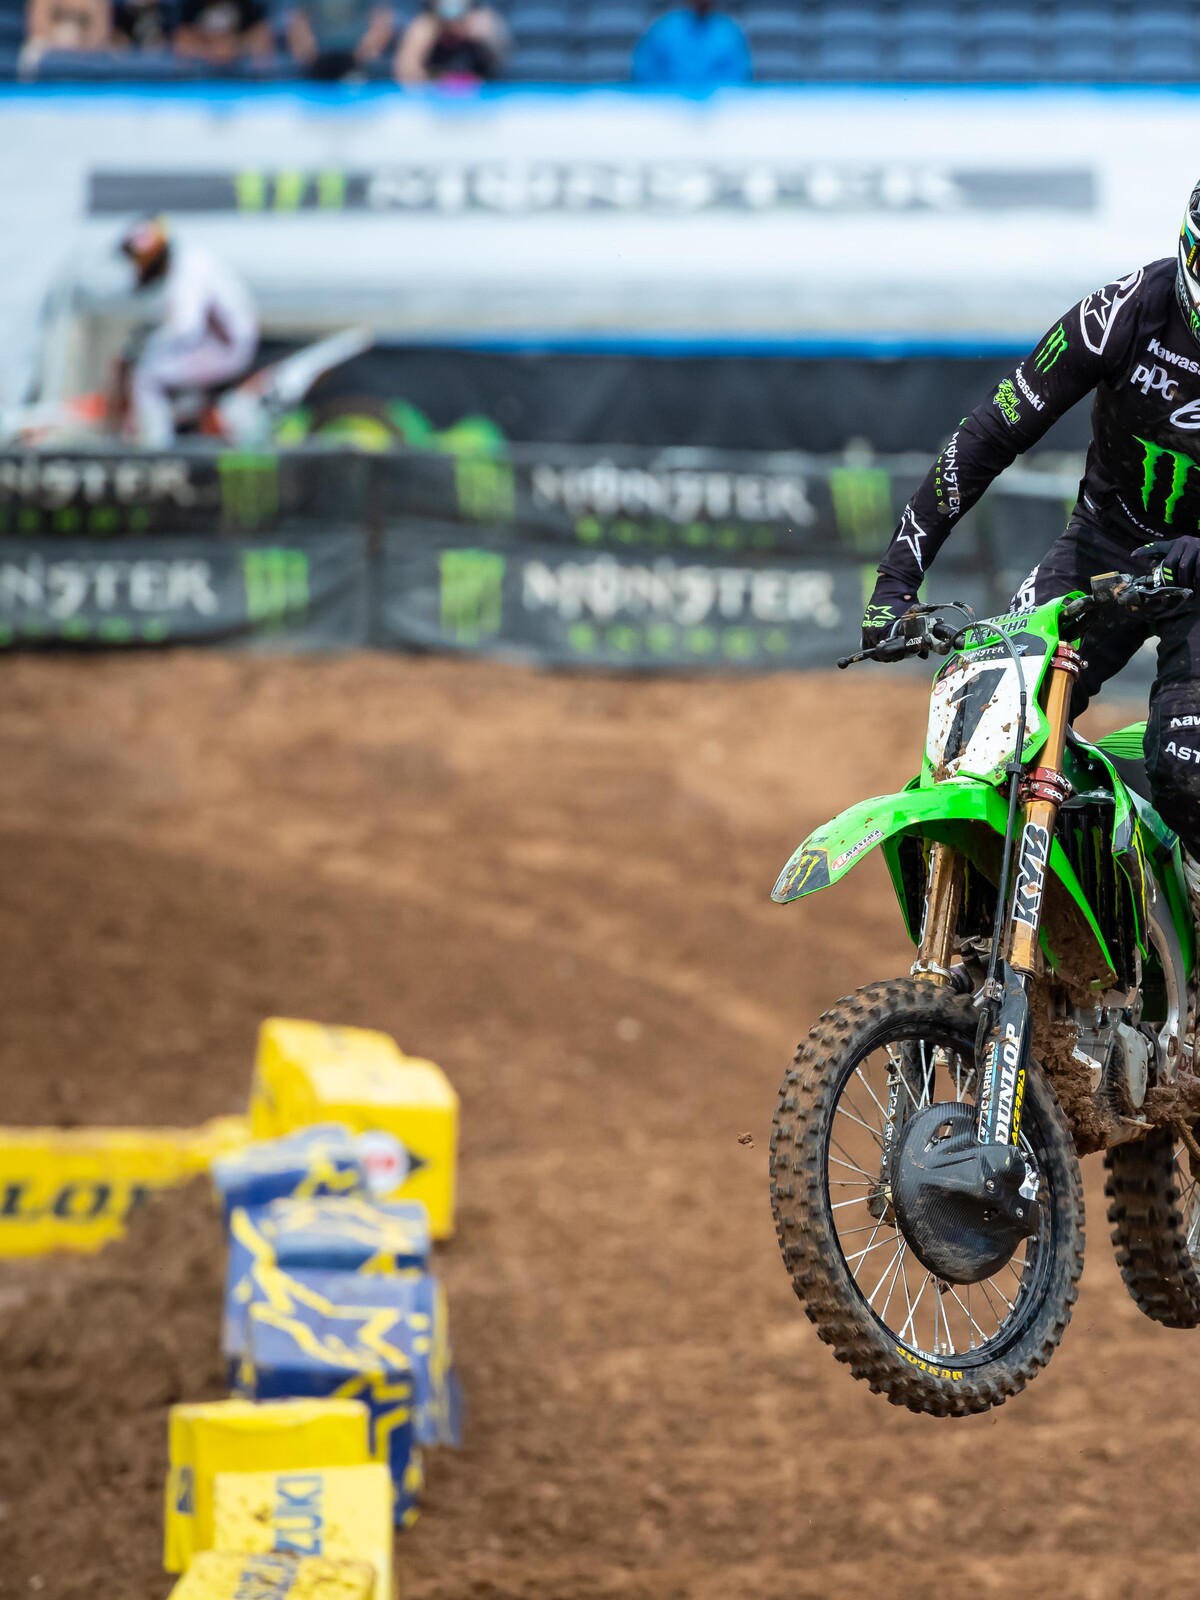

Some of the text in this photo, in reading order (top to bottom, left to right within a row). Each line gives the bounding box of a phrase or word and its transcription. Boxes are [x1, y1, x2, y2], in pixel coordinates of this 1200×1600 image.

[935, 447, 947, 508] NERGY
[943, 432, 961, 518] MONSTER
[995, 1022, 1020, 1147] DUNLOP
[895, 1345, 964, 1381] DUNLOP
